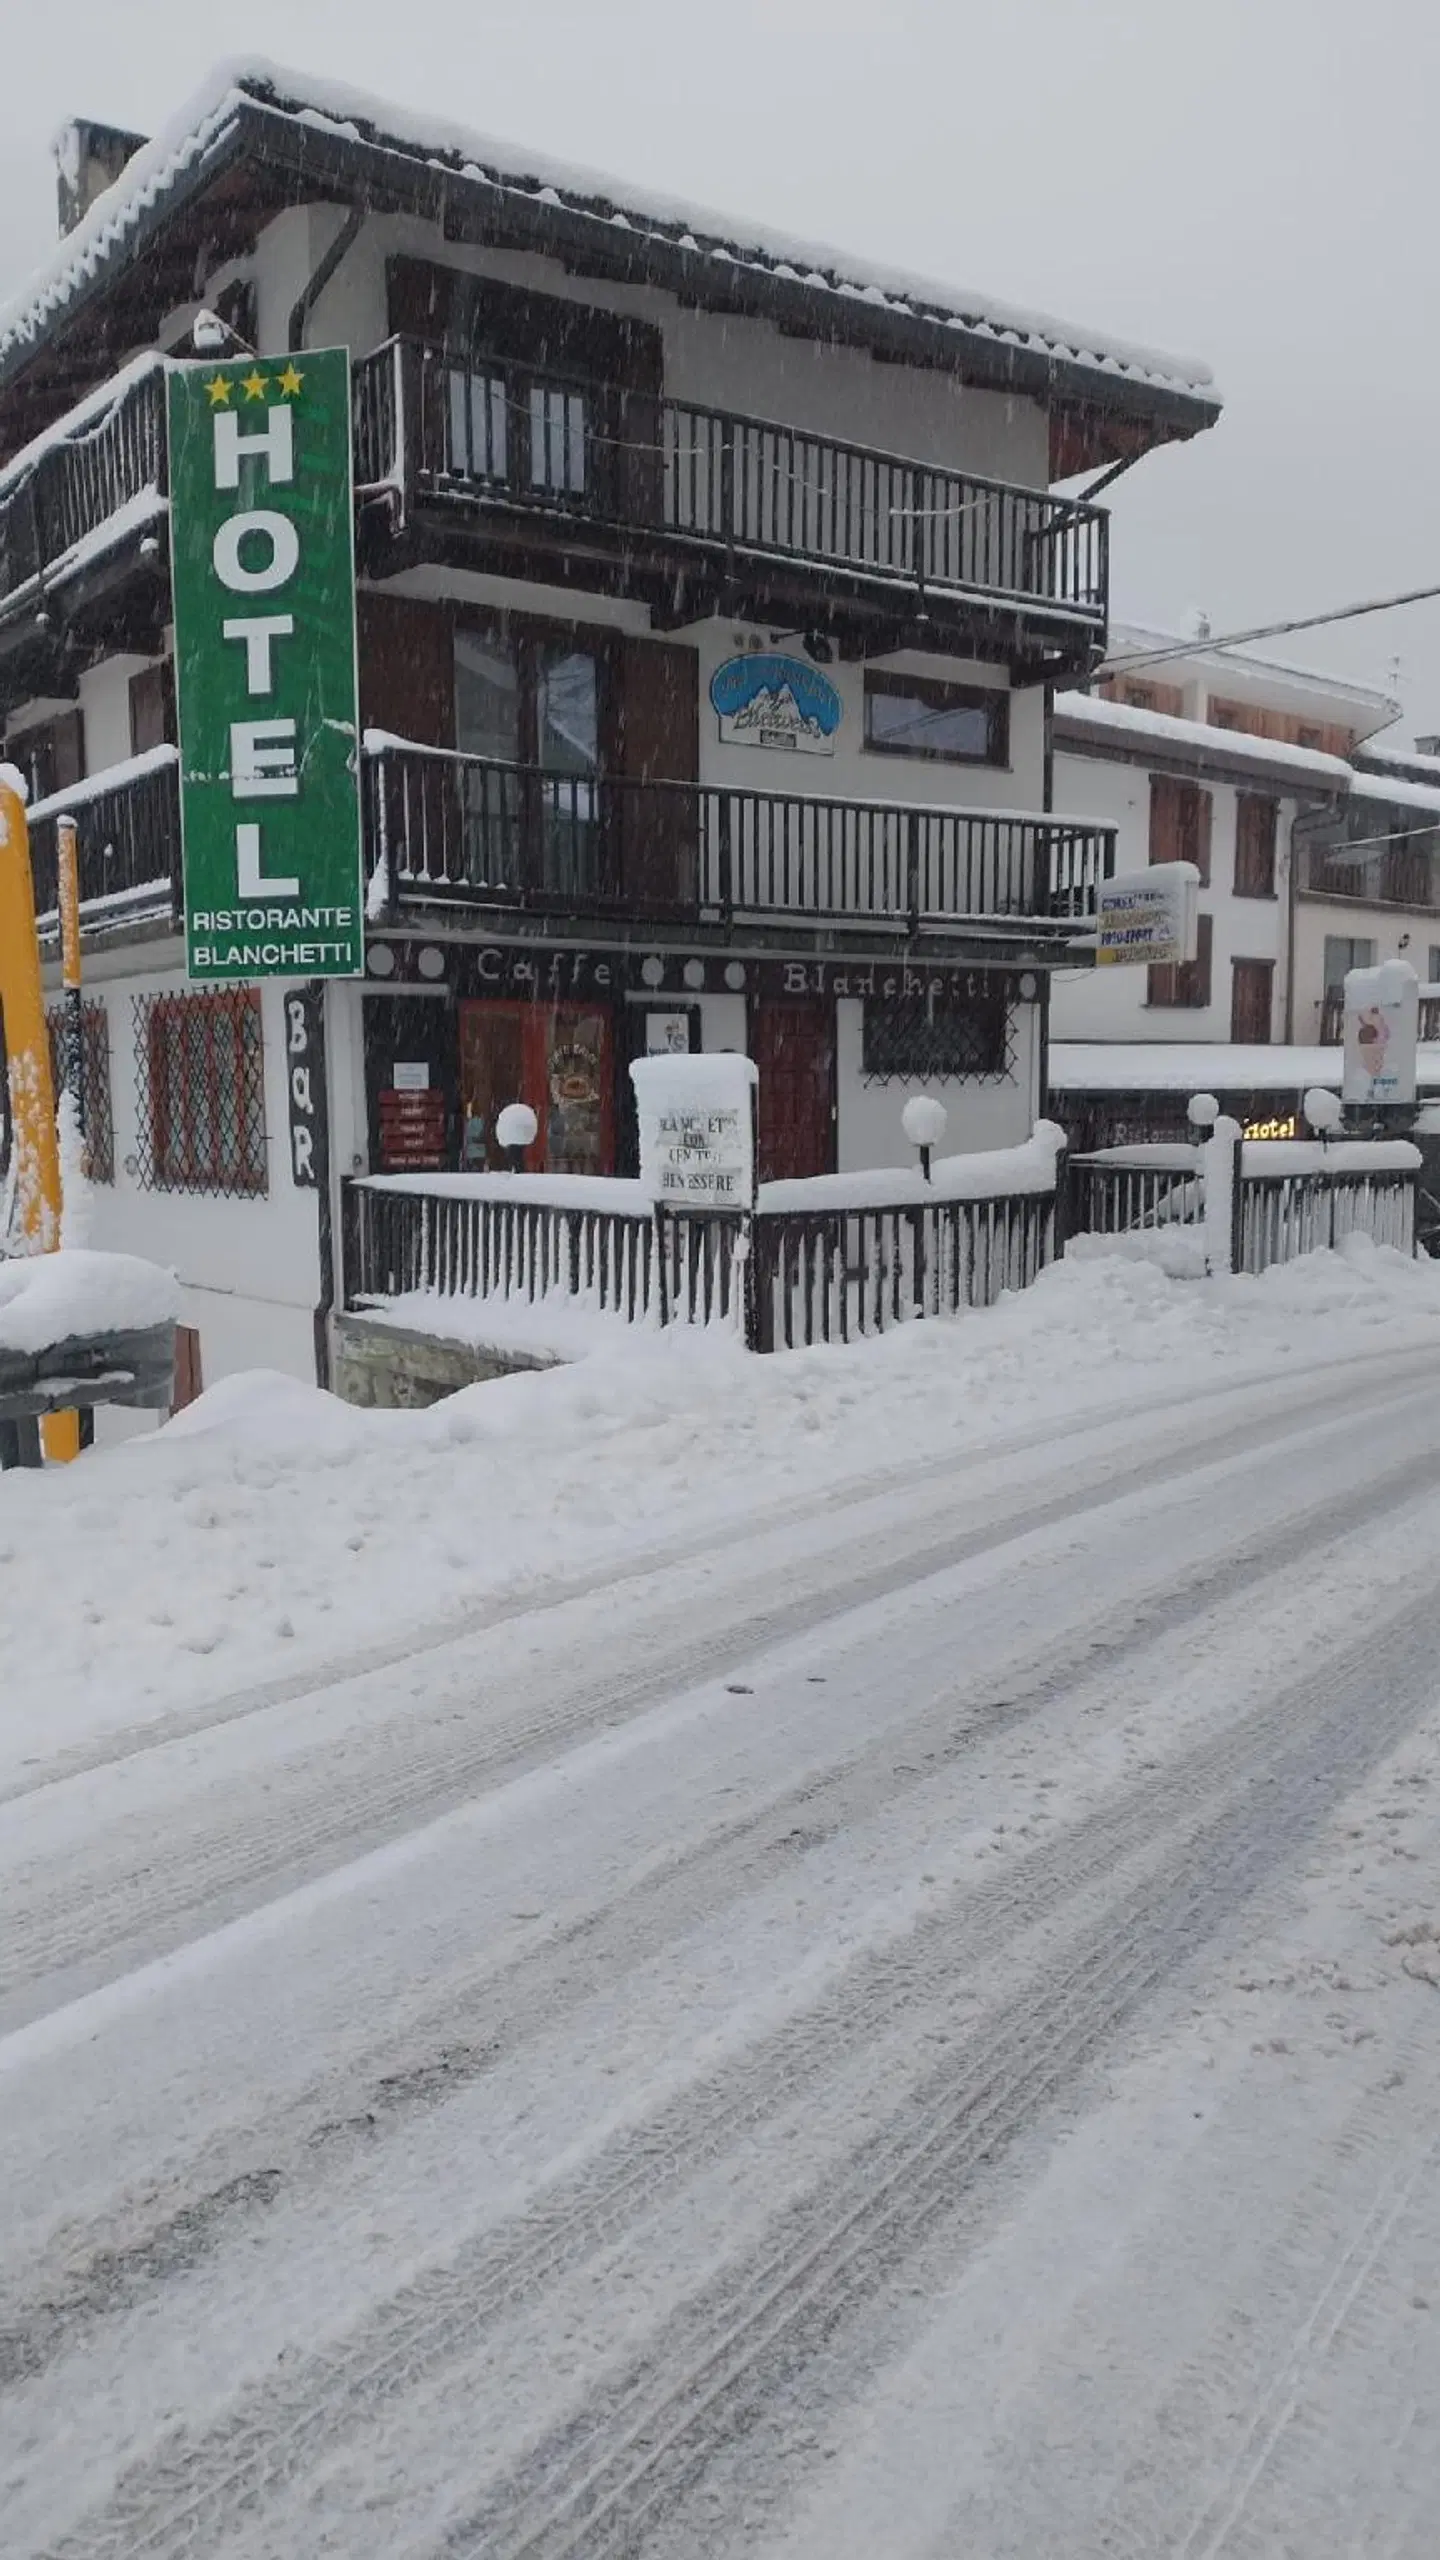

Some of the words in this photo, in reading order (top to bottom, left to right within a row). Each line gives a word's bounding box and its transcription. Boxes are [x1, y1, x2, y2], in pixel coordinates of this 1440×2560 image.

[213, 404, 301, 899] HOTEL
[193, 907, 352, 931] RISTORANTE
[194, 943, 352, 966] BLANCHETTI
